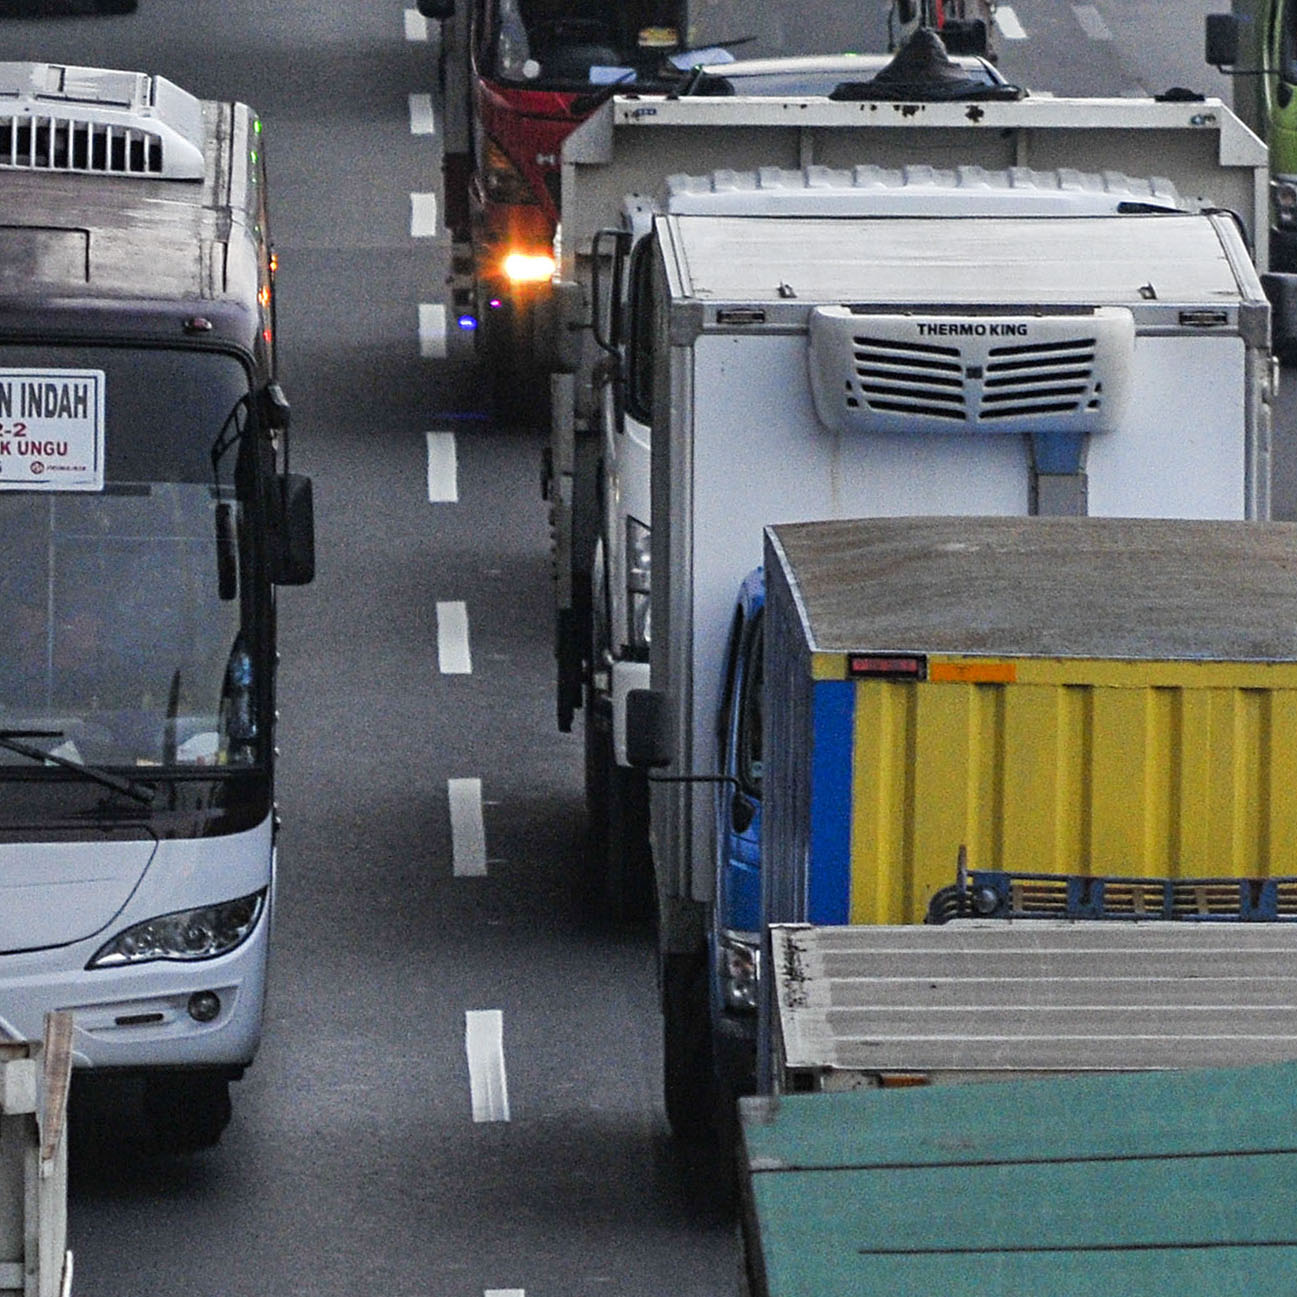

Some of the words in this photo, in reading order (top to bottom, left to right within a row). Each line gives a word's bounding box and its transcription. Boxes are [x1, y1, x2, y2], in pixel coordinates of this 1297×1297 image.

[917, 323, 986, 336] THERMO
[989, 323, 1028, 336] KING
[20, 383, 88, 419] INDAH
[17, 441, 68, 456] UNGU
